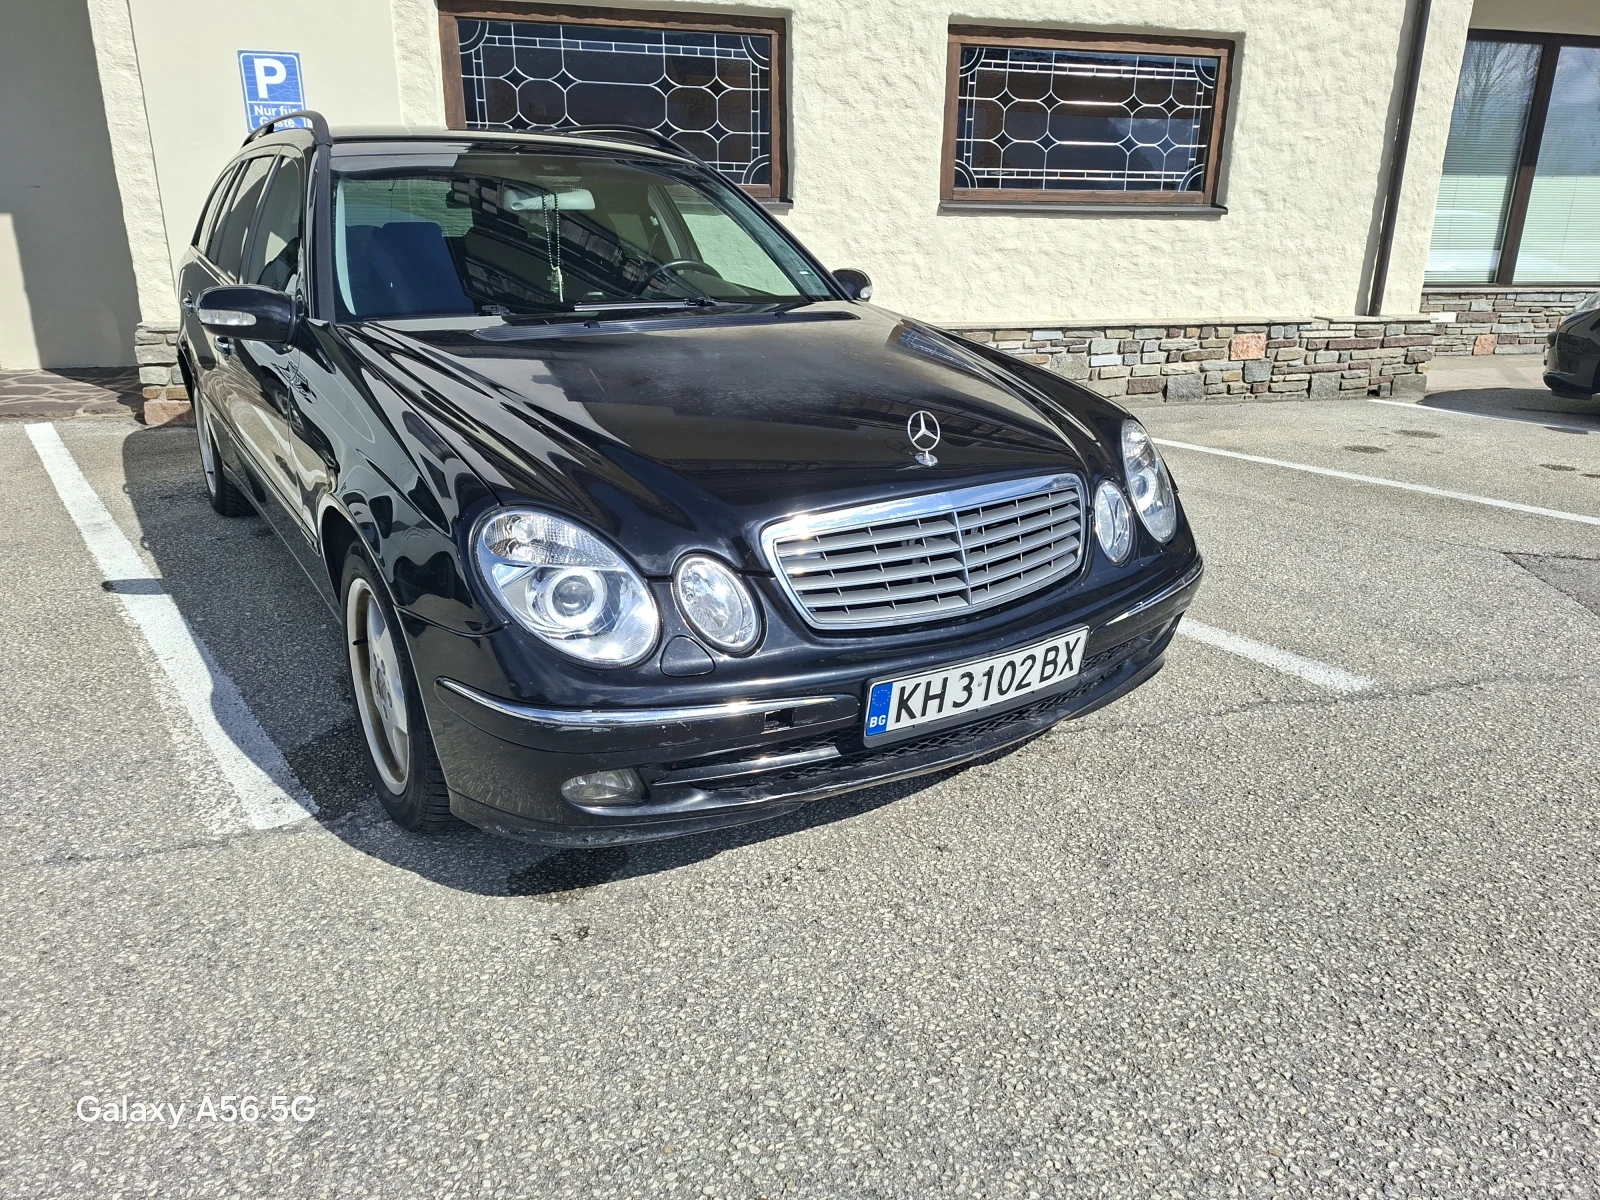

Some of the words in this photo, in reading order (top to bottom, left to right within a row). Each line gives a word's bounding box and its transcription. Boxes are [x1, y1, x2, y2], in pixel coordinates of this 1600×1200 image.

[254, 58, 286, 98] P
[253, 105, 277, 116] Nur
[259, 117, 296, 128] Gste
[869, 715, 886, 728] BG
